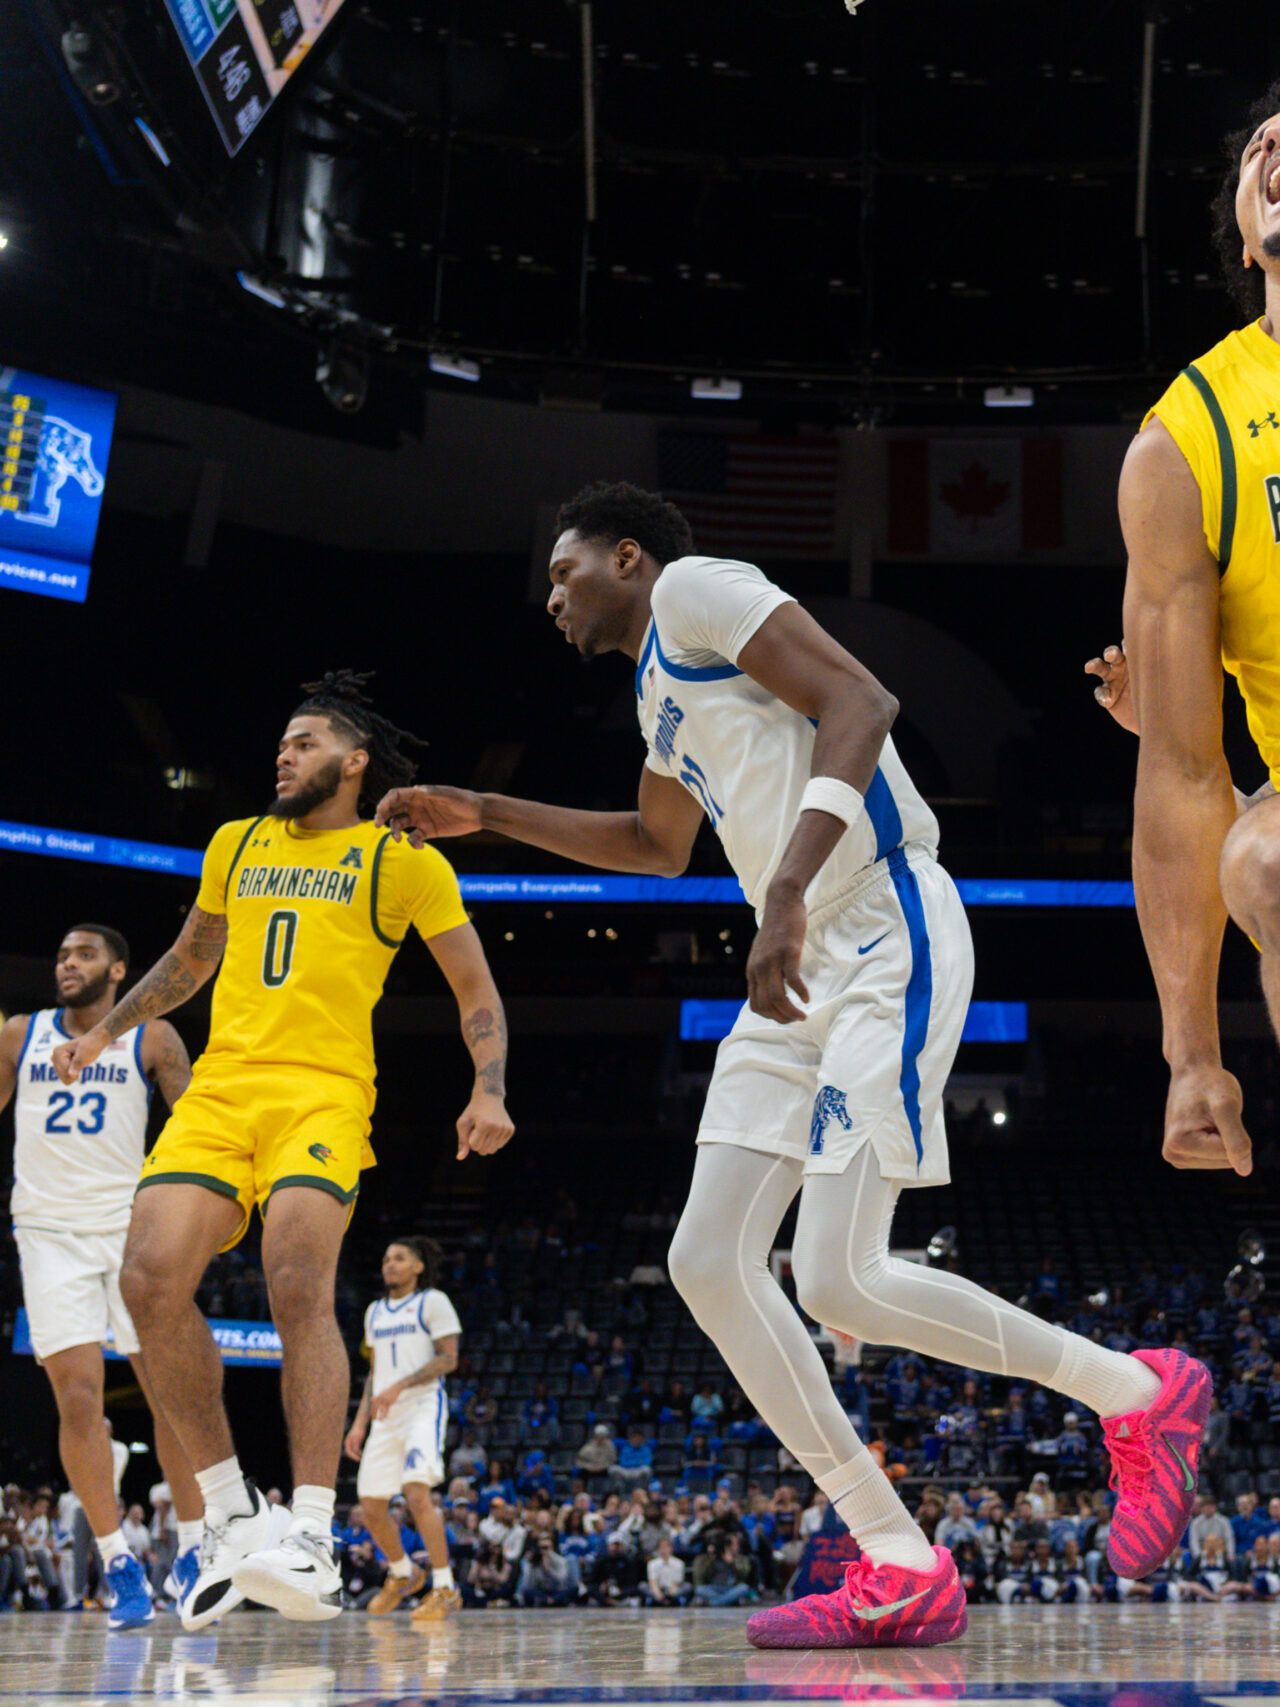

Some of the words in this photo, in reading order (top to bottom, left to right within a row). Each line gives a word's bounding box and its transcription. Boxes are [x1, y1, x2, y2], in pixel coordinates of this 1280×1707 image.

[45, 832, 96, 854] Global
[236, 864, 359, 906] BIRMINGHAM
[261, 908, 300, 990] 0
[29, 1062, 129, 1085] Mephis
[45, 1090, 107, 1136] 23
